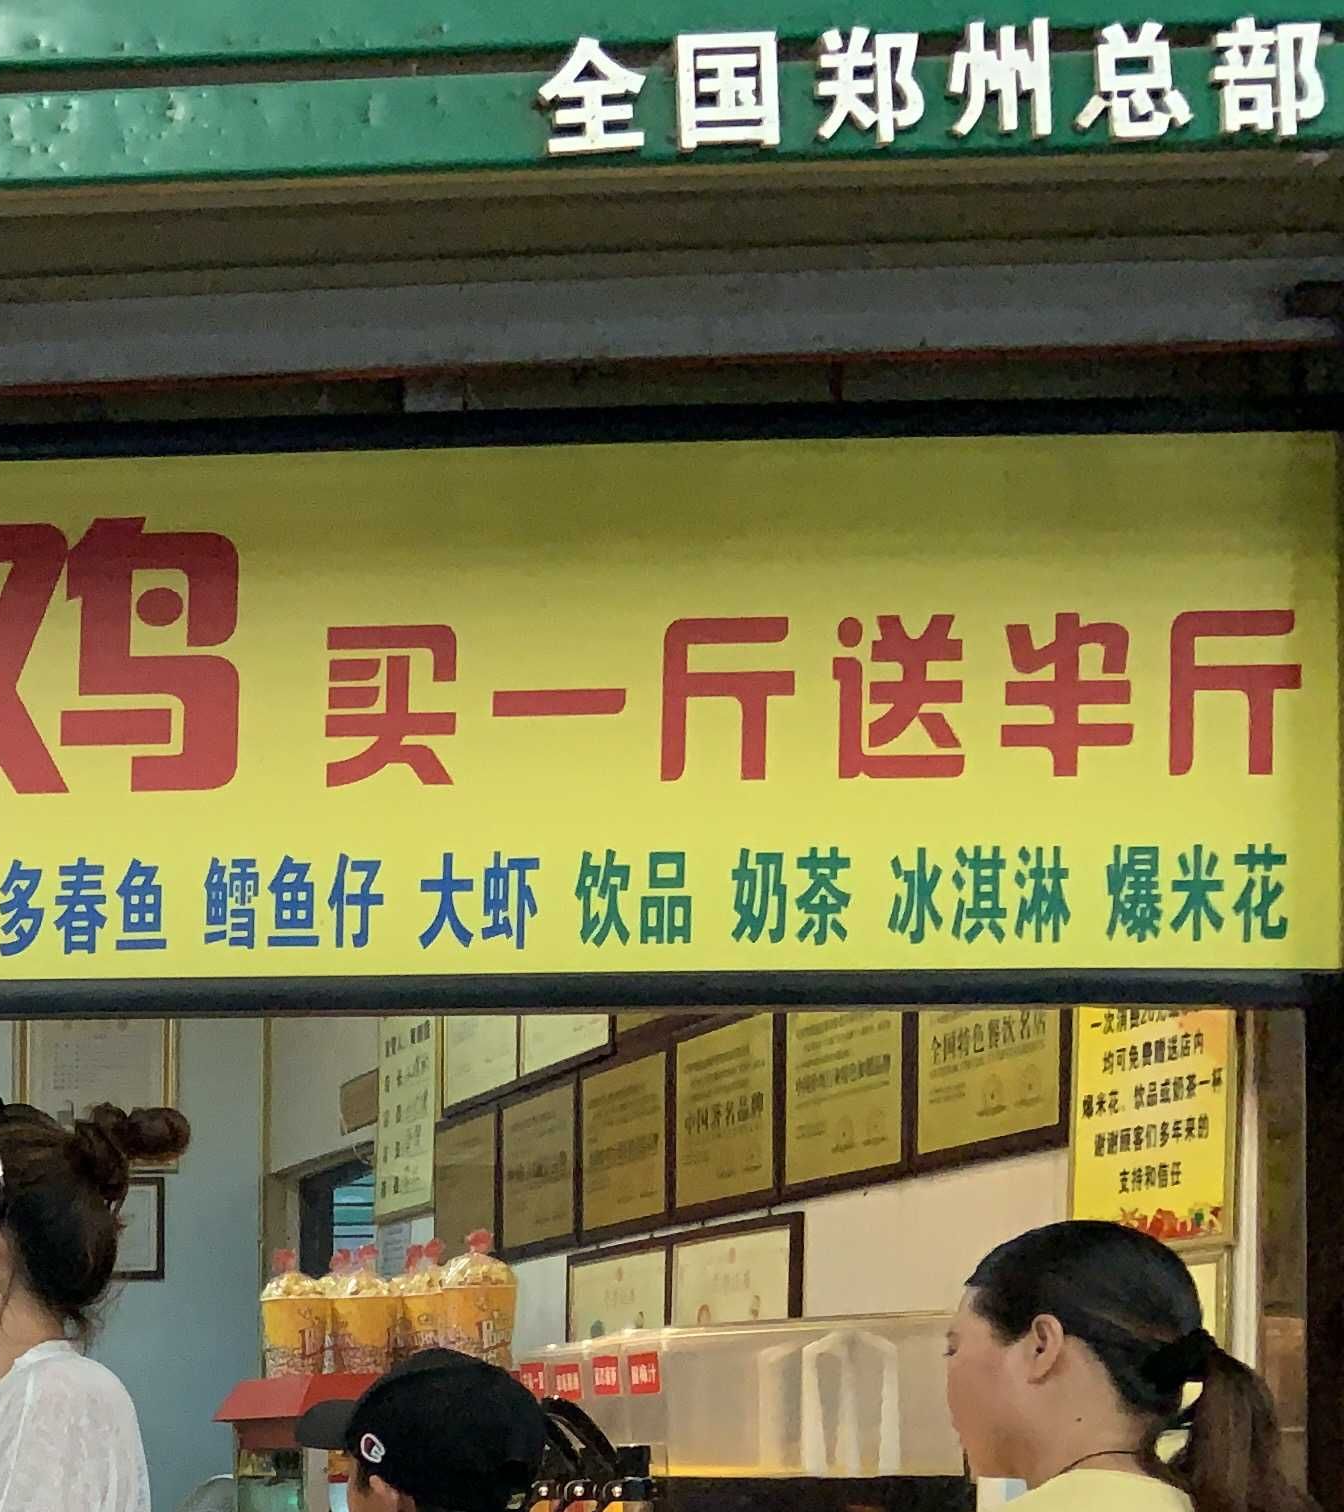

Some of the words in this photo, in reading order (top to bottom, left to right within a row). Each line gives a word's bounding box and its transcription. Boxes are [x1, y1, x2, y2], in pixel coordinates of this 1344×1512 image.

[538, 17, 1327, 156] 全国郑州总部
[324, 608, 1302, 788] 买一斤送半斤
[203, 853, 383, 953] 鳕鱼仔
[419, 852, 540, 951] 大虾
[574, 849, 693, 949] 饮品
[731, 846, 853, 948] 奶茶
[889, 845, 1070, 947] 冰淇淋
[1105, 843, 1289, 943] 爆米花
